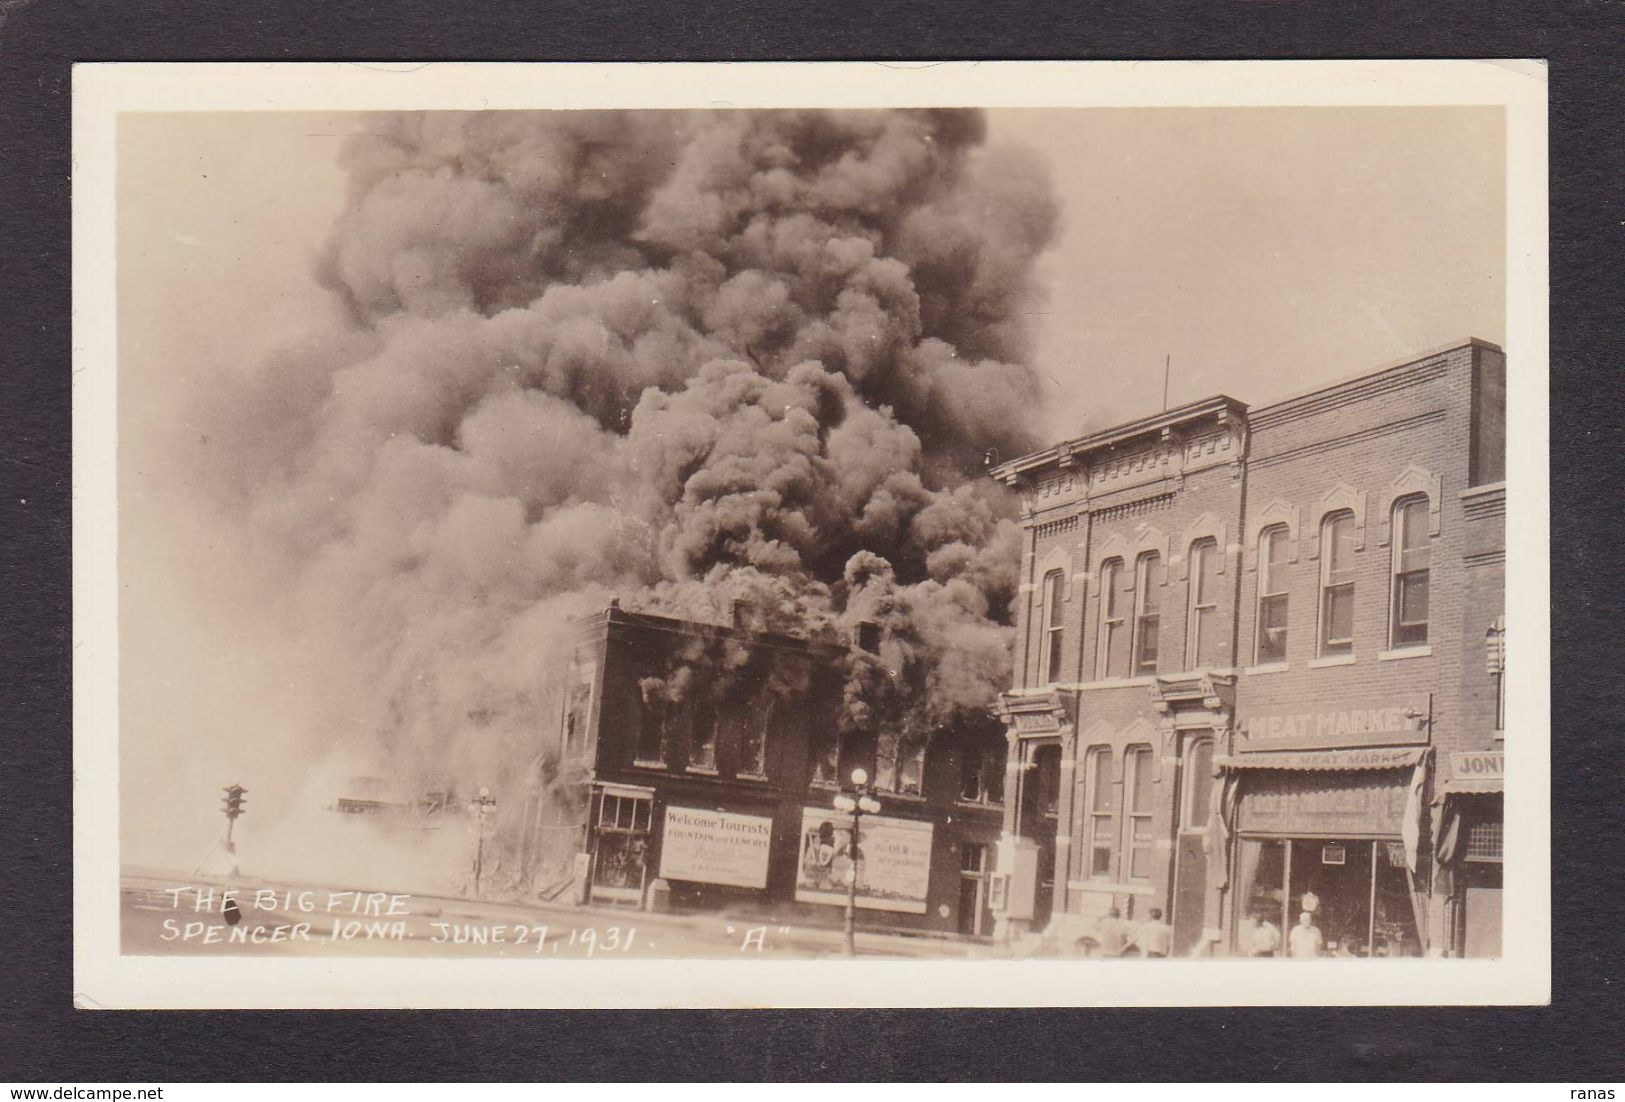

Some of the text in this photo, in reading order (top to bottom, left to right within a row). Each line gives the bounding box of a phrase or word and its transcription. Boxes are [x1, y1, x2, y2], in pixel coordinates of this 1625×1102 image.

[1249, 706, 1413, 739] MEAT MARKET
[668, 812, 769, 835] Welcome Tourists
